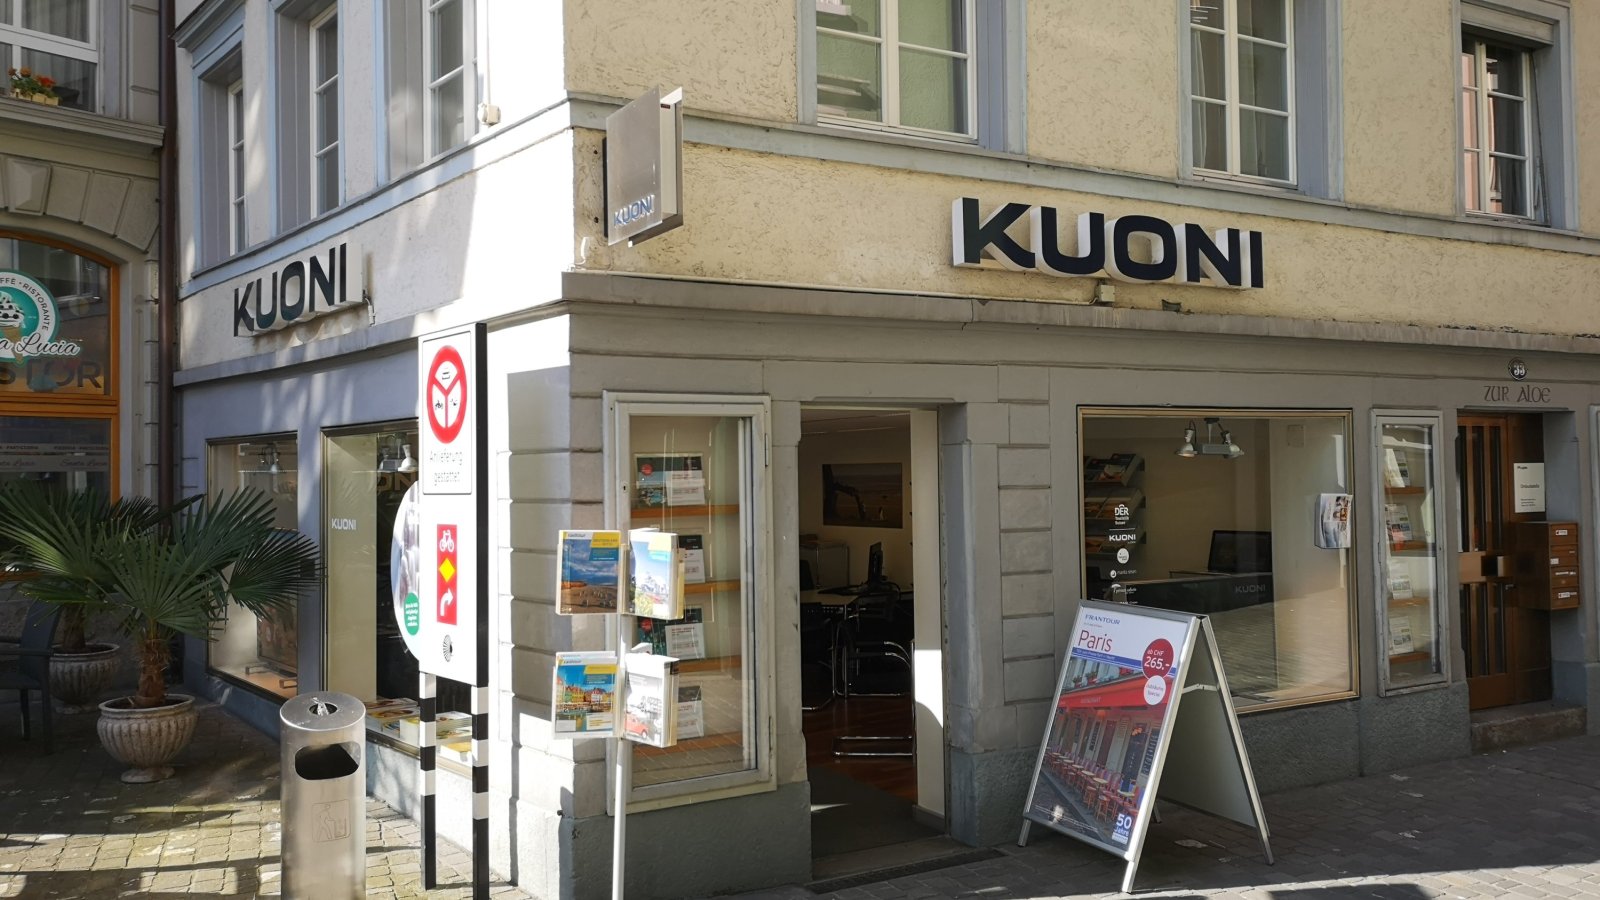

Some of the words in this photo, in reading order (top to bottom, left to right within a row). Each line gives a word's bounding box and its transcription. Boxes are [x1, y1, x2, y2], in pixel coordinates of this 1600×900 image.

[613, 195, 655, 227] KUONI
[956, 197, 1263, 289] KUONI
[234, 243, 347, 337] KUONI
[22, 282, 50, 331] RISTORANTE
[16, 333, 78, 354] Lucia
[1484, 385, 1510, 402] ZUR
[1114, 506, 1130, 516] DER
[331, 518, 357, 530] KUONI
[1108, 534, 1137, 542] KUONI
[1235, 584, 1266, 594] KUONI
[1084, 613, 1121, 625] FRANTOUR
[1078, 629, 1113, 653] Paris
[1144, 656, 1171, 671] 265.-
[1116, 813, 1132, 829] 50
[1114, 826, 1129, 837] Jahre
